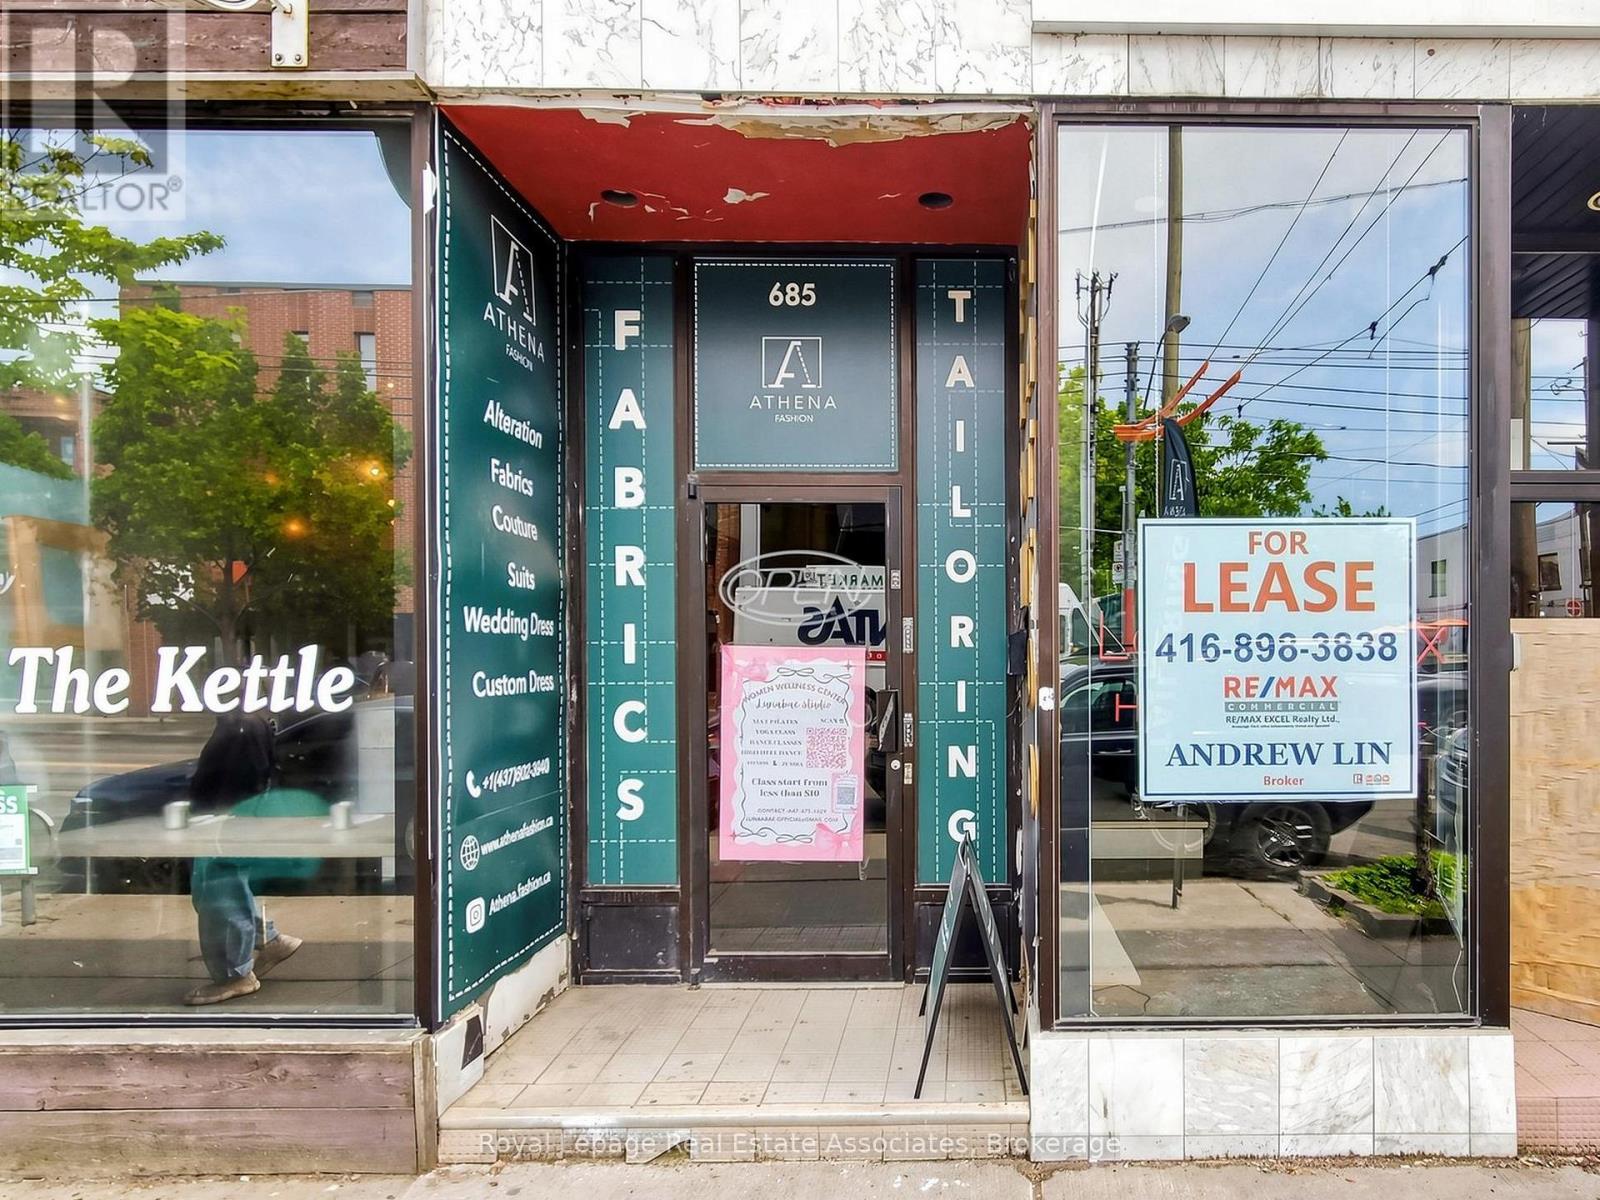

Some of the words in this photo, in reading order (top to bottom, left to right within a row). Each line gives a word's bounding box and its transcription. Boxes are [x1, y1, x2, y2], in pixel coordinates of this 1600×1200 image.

[768, 281, 817, 307] 685
[483, 302, 545, 362] ATHENA
[505, 343, 534, 372] FASHION
[749, 395, 838, 410] ATHENA
[483, 399, 543, 450] Alteration
[774, 414, 814, 423] FASHION
[490, 457, 534, 497] Fabrics
[491, 504, 538, 542] Couture
[1248, 530, 1309, 556] FOR
[507, 561, 536, 591] Suits
[608, 310, 648, 822] FABRICS
[945, 290, 979, 844] TAILORING
[1183, 560, 1376, 613] LEASE
[463, 605, 529, 641] Wedding
[530, 612, 554, 637] Dress
[1154, 631, 1398, 664] 416-898-3838
[8, 645, 132, 715] The
[151, 643, 356, 714] Kettle
[472, 670, 527, 698] Custom
[529, 669, 554, 693] Dress
[744, 685, 775, 703] WOMEN
[775, 682, 816, 691] WELLNESS
[817, 686, 846, 705] CENTER
[1223, 675, 1339, 699] RE/MAX
[1225, 714, 1262, 724] RE/MAX
[1264, 714, 1291, 723] EXCEL
[1292, 714, 1320, 726] Realty
[1227, 702, 1336, 711] COMMERCIAL
[1165, 742, 1325, 768] ANDREW
[1332, 741, 1393, 765] LIN
[760, 788, 779, 797] less
[780, 788, 802, 797] than
[803, 778, 828, 786] from
[1263, 775, 1305, 787] Broker
